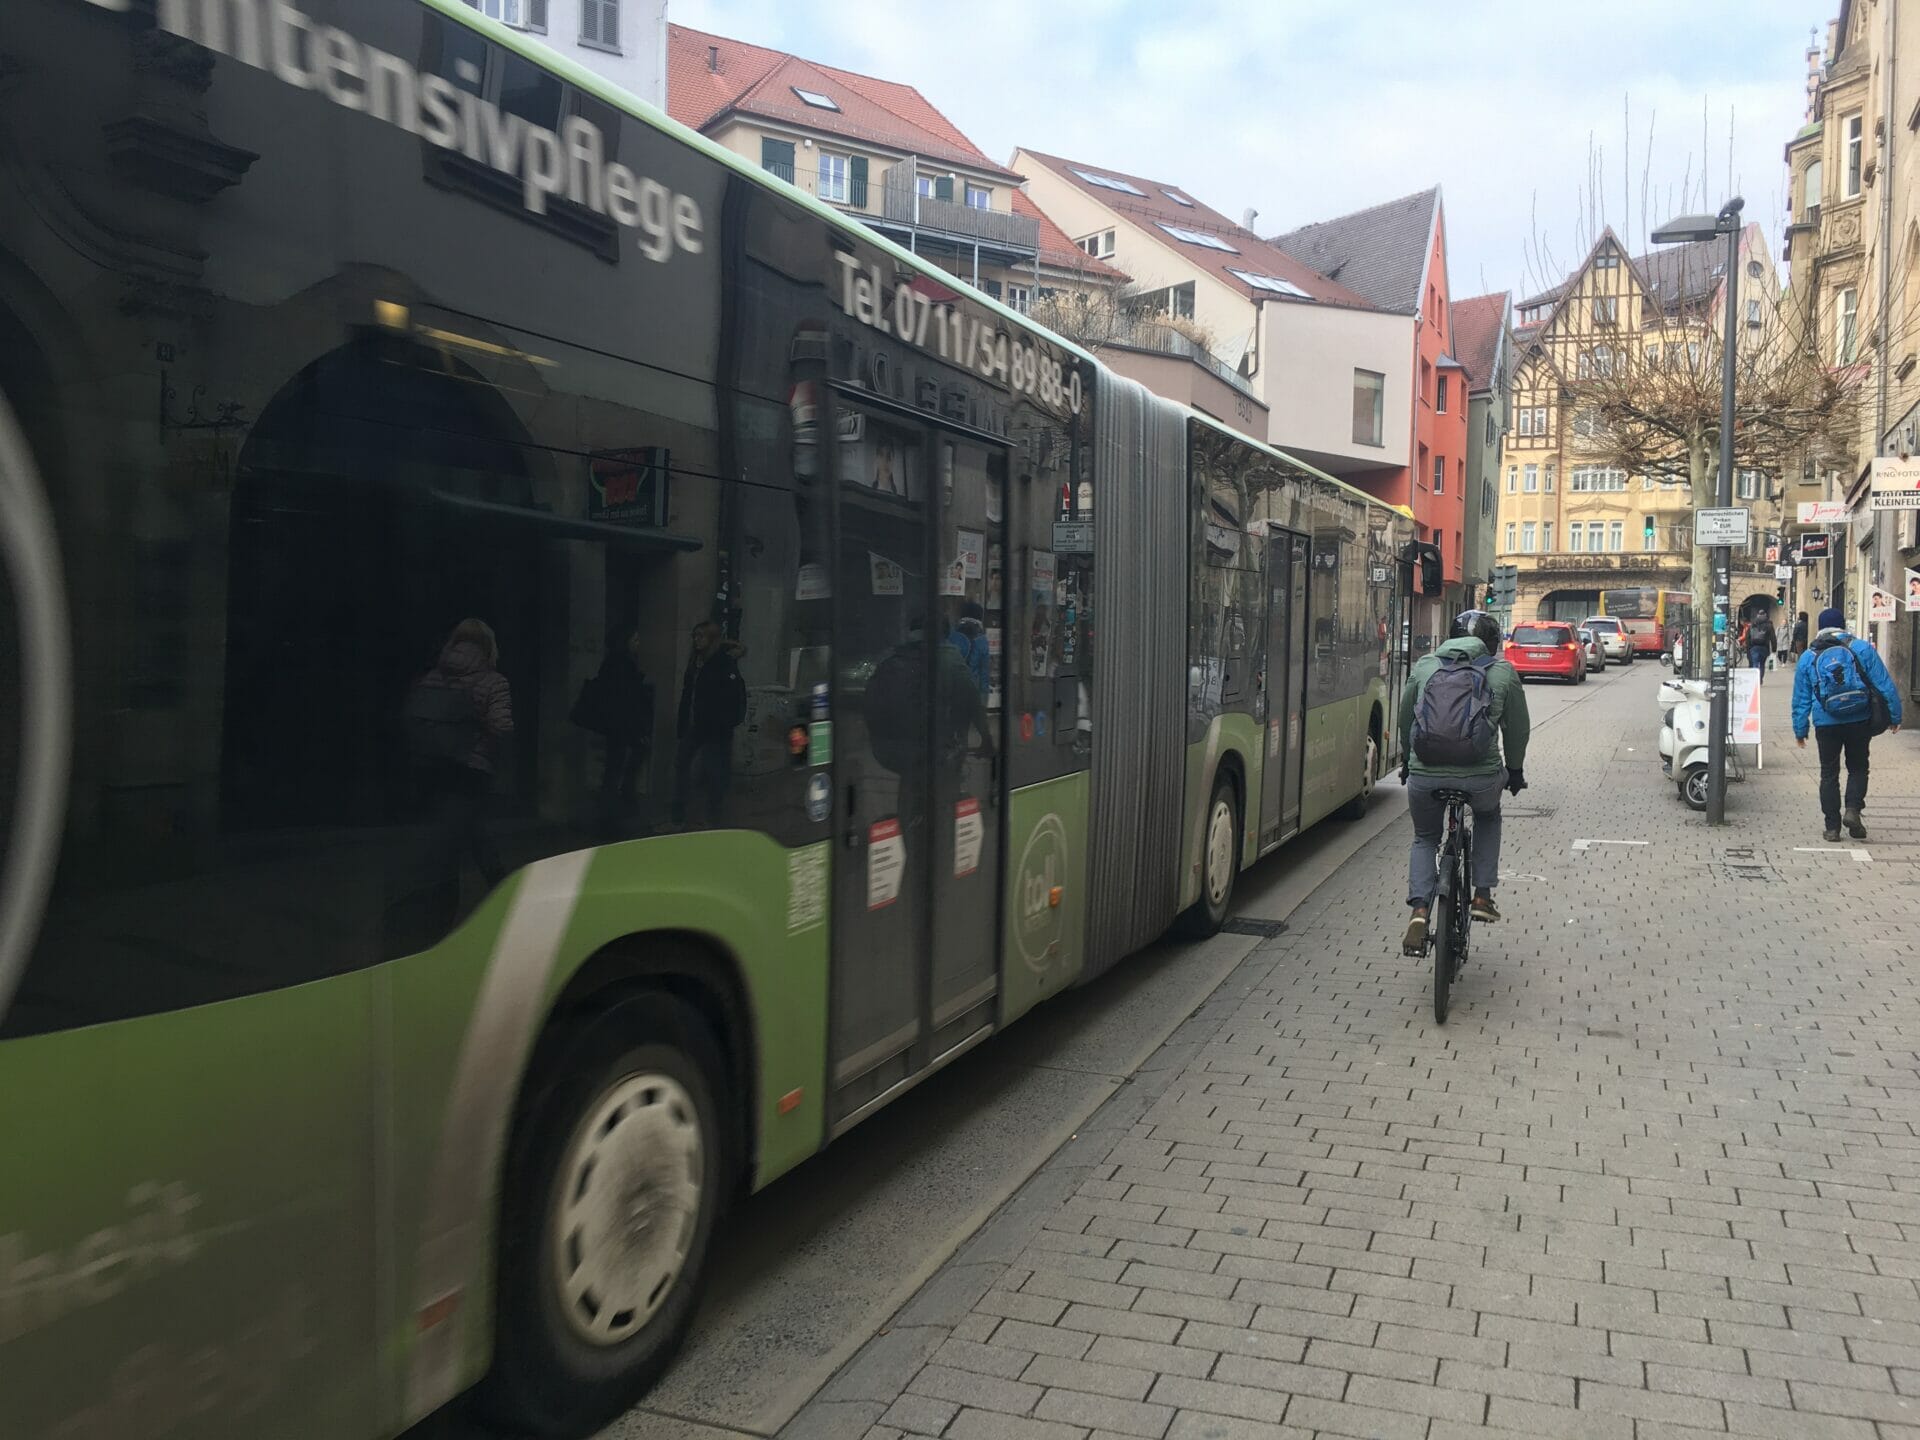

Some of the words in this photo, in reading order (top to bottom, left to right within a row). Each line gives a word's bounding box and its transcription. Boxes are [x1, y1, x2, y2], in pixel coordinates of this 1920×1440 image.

[157, 0, 704, 263] ntensivpflege
[834, 250, 891, 333] Tel.
[1536, 553, 1614, 569] Deutsche
[1619, 553, 1660, 570] Bank
